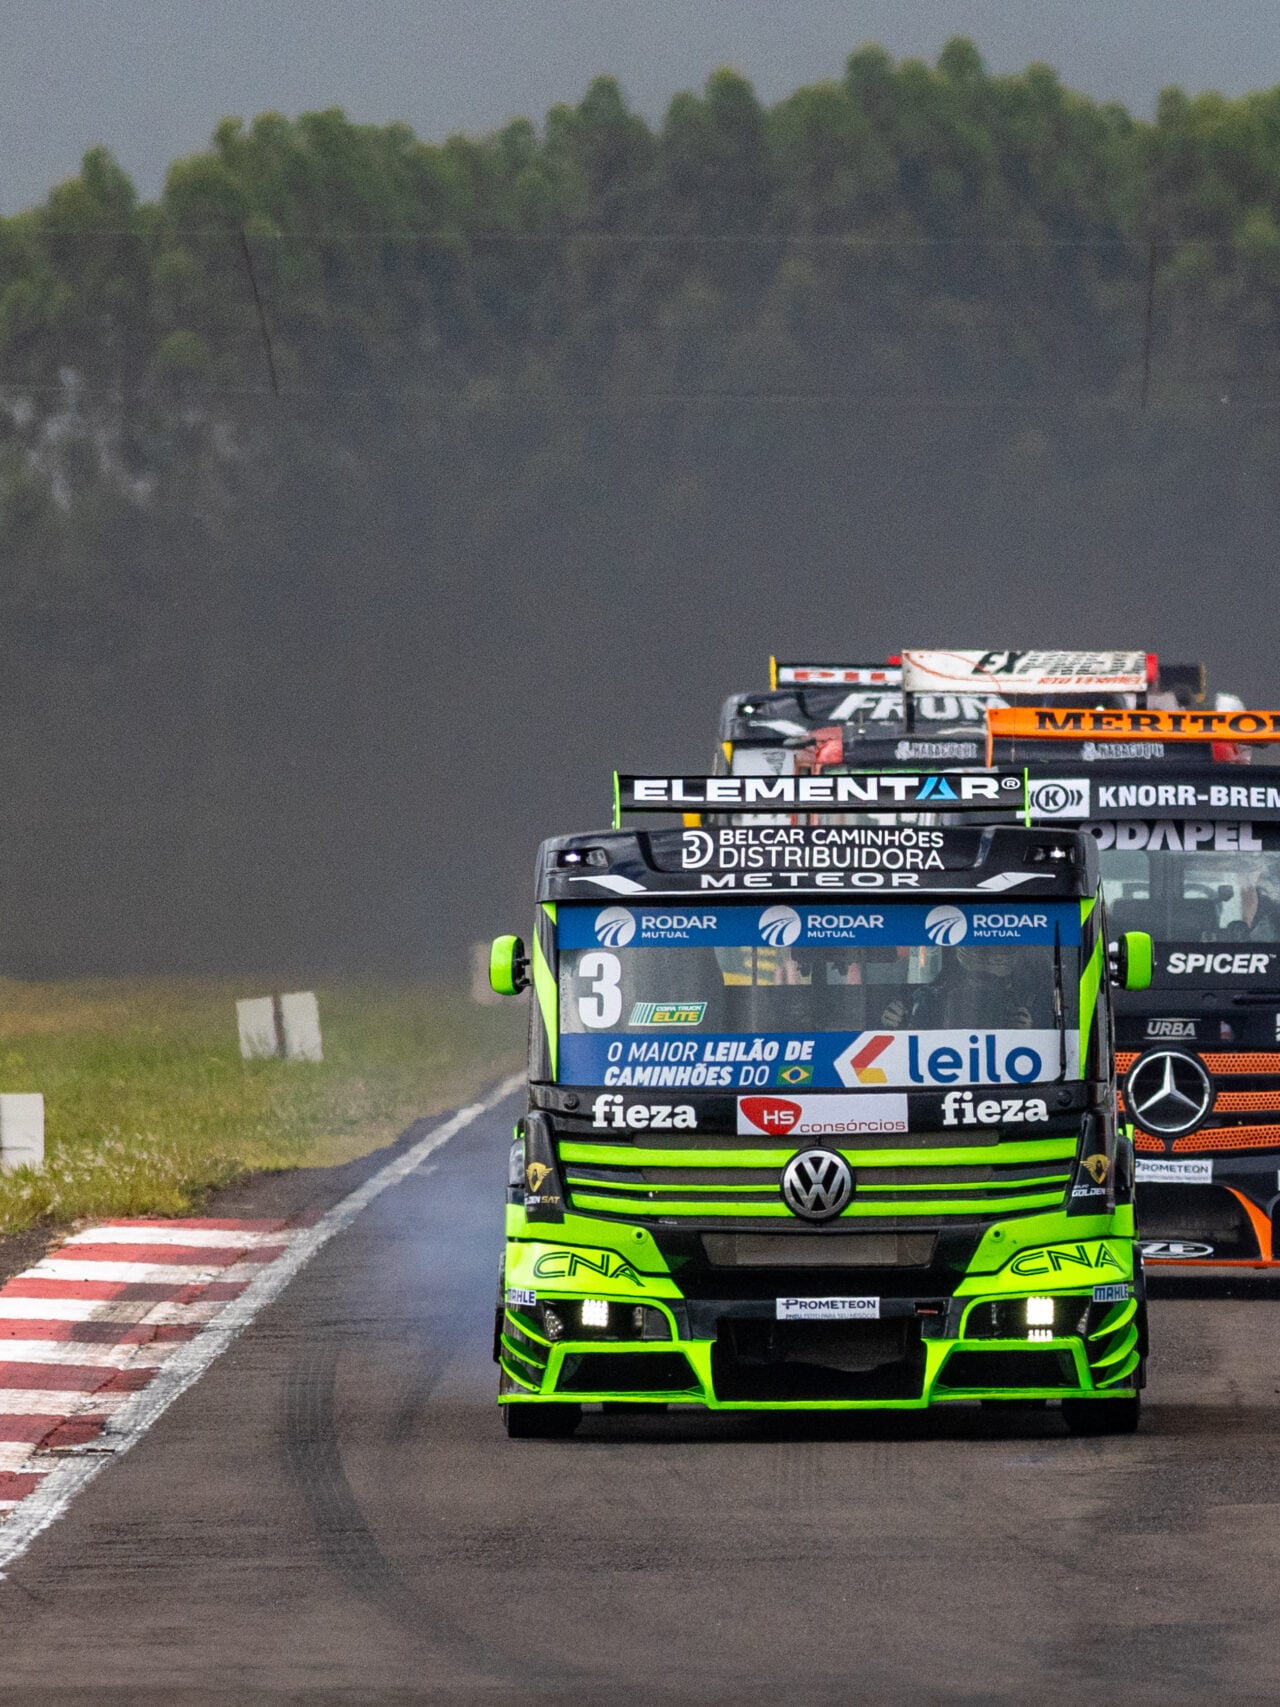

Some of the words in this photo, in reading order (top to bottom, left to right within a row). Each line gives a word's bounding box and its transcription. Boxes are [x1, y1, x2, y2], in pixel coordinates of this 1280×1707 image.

[719, 829, 804, 844] BELCAR
[811, 828, 944, 847] CAMINHÕES
[719, 846, 945, 869] DISTRIBUIDORA
[701, 872, 920, 888] METEOR
[641, 915, 717, 929] RODAR
[807, 914, 884, 928] RODAR
[973, 914, 1048, 928] RODAR
[641, 931, 690, 939] MUTUAL
[807, 930, 856, 938] MUTUAL
[578, 952, 622, 1029] 3
[653, 1011, 700, 1022] ELITE
[1146, 1021, 1196, 1036] URBA
[608, 1042, 623, 1062] O
[628, 1041, 698, 1062] MAIOR
[703, 1038, 780, 1061] LEILÃO
[785, 1041, 815, 1060] DE
[908, 1034, 1042, 1083] leilo
[604, 1063, 734, 1086] CAMINHÕES
[739, 1065, 769, 1085] DO
[591, 1094, 698, 1128] fieza
[941, 1091, 1049, 1125] fieza
[763, 1110, 795, 1125] HS
[800, 1118, 906, 1133] consórcios
[1010, 1242, 1126, 1277] CNA
[533, 1250, 645, 1288] CNA
[781, 1299, 876, 1310] PROMETEON
